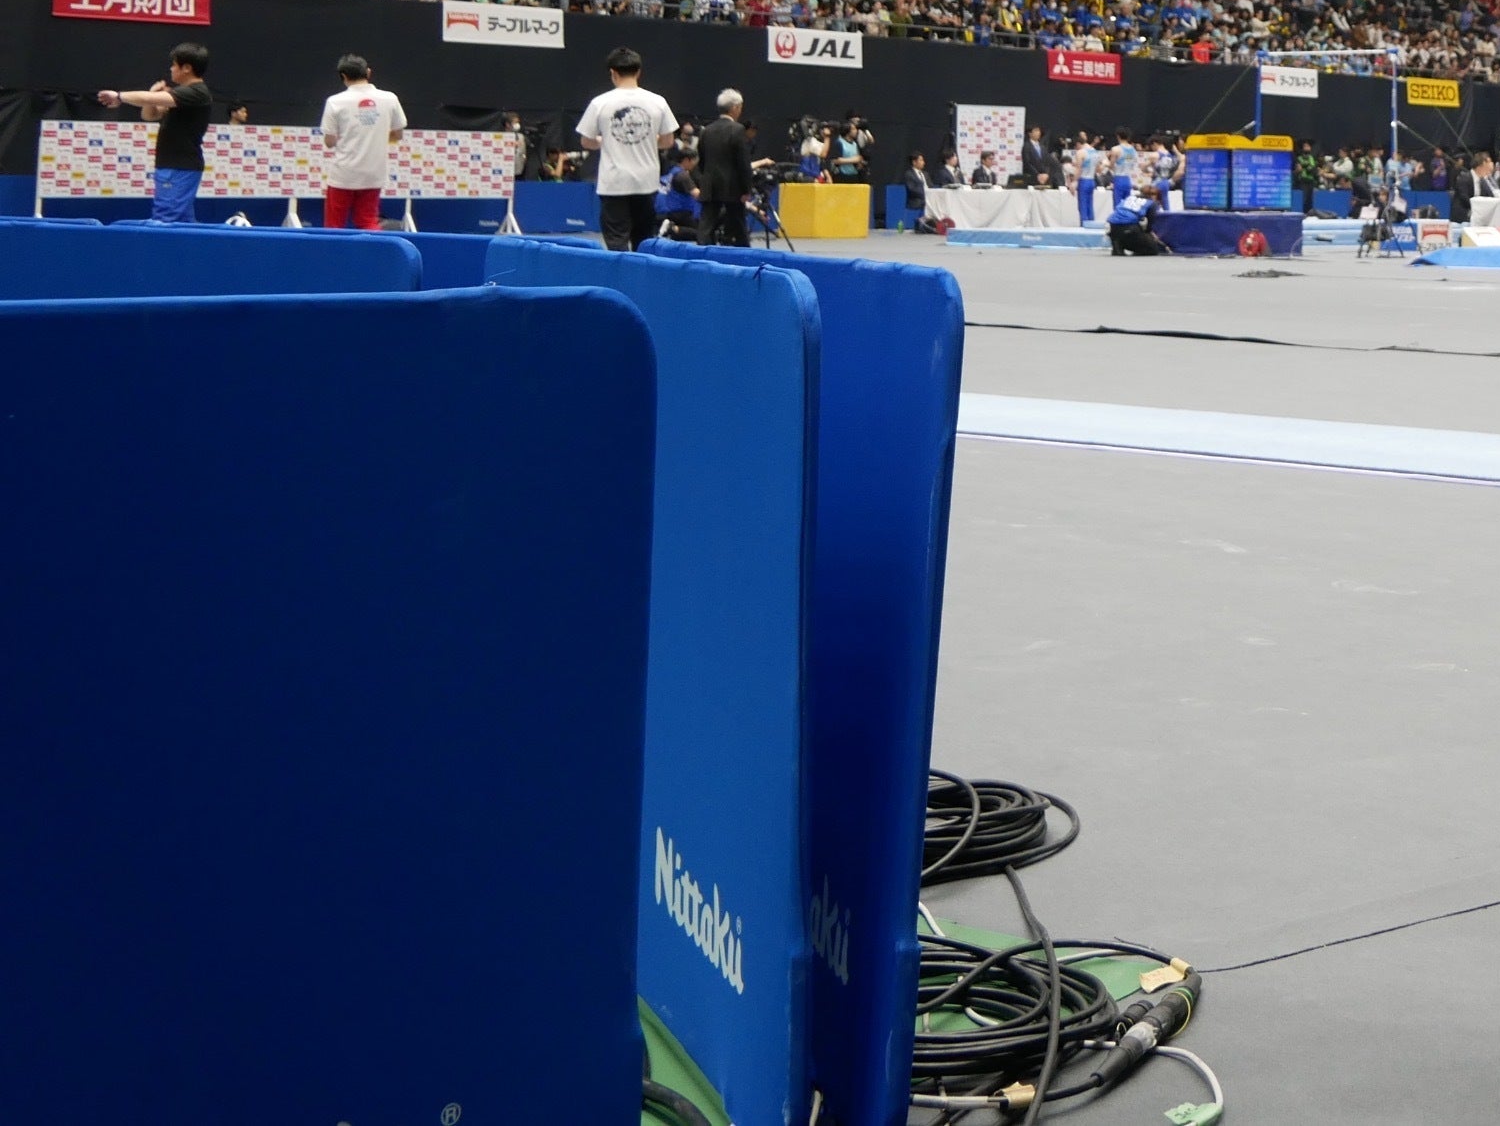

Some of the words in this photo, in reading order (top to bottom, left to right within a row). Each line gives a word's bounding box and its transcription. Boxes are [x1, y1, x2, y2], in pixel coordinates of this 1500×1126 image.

[488, 16, 560, 35] テーブルマーク
[802, 37, 855, 59] JAL
[1410, 83, 1457, 102] SEIKO
[655, 826, 744, 995] Nittaku
